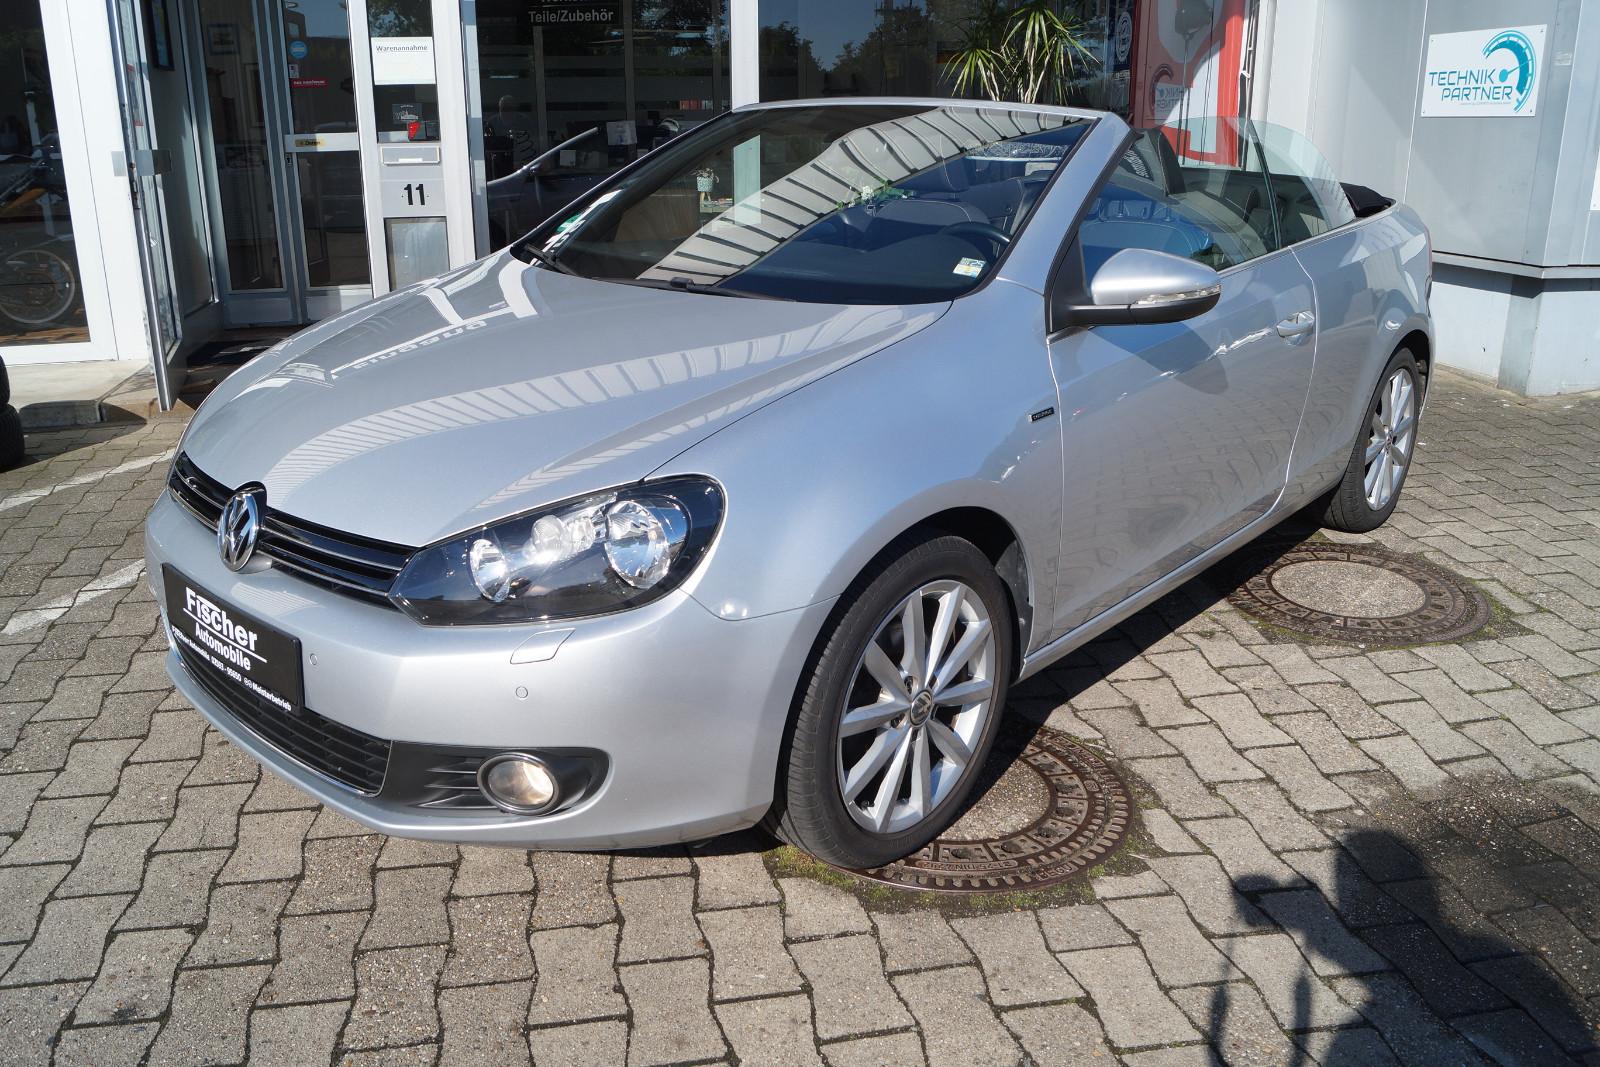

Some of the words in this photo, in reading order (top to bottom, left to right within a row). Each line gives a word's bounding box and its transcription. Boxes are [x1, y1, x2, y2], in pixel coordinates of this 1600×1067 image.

[528, 8, 614, 23] Teile/Zubehör
[376, 44, 428, 52] Warenannahme
[1429, 69, 1496, 86] TECHNIK
[1441, 86, 1513, 101] PARTNER
[403, 183, 426, 206] 11
[185, 586, 258, 652] Fischer
[195, 622, 252, 671] Automobile
